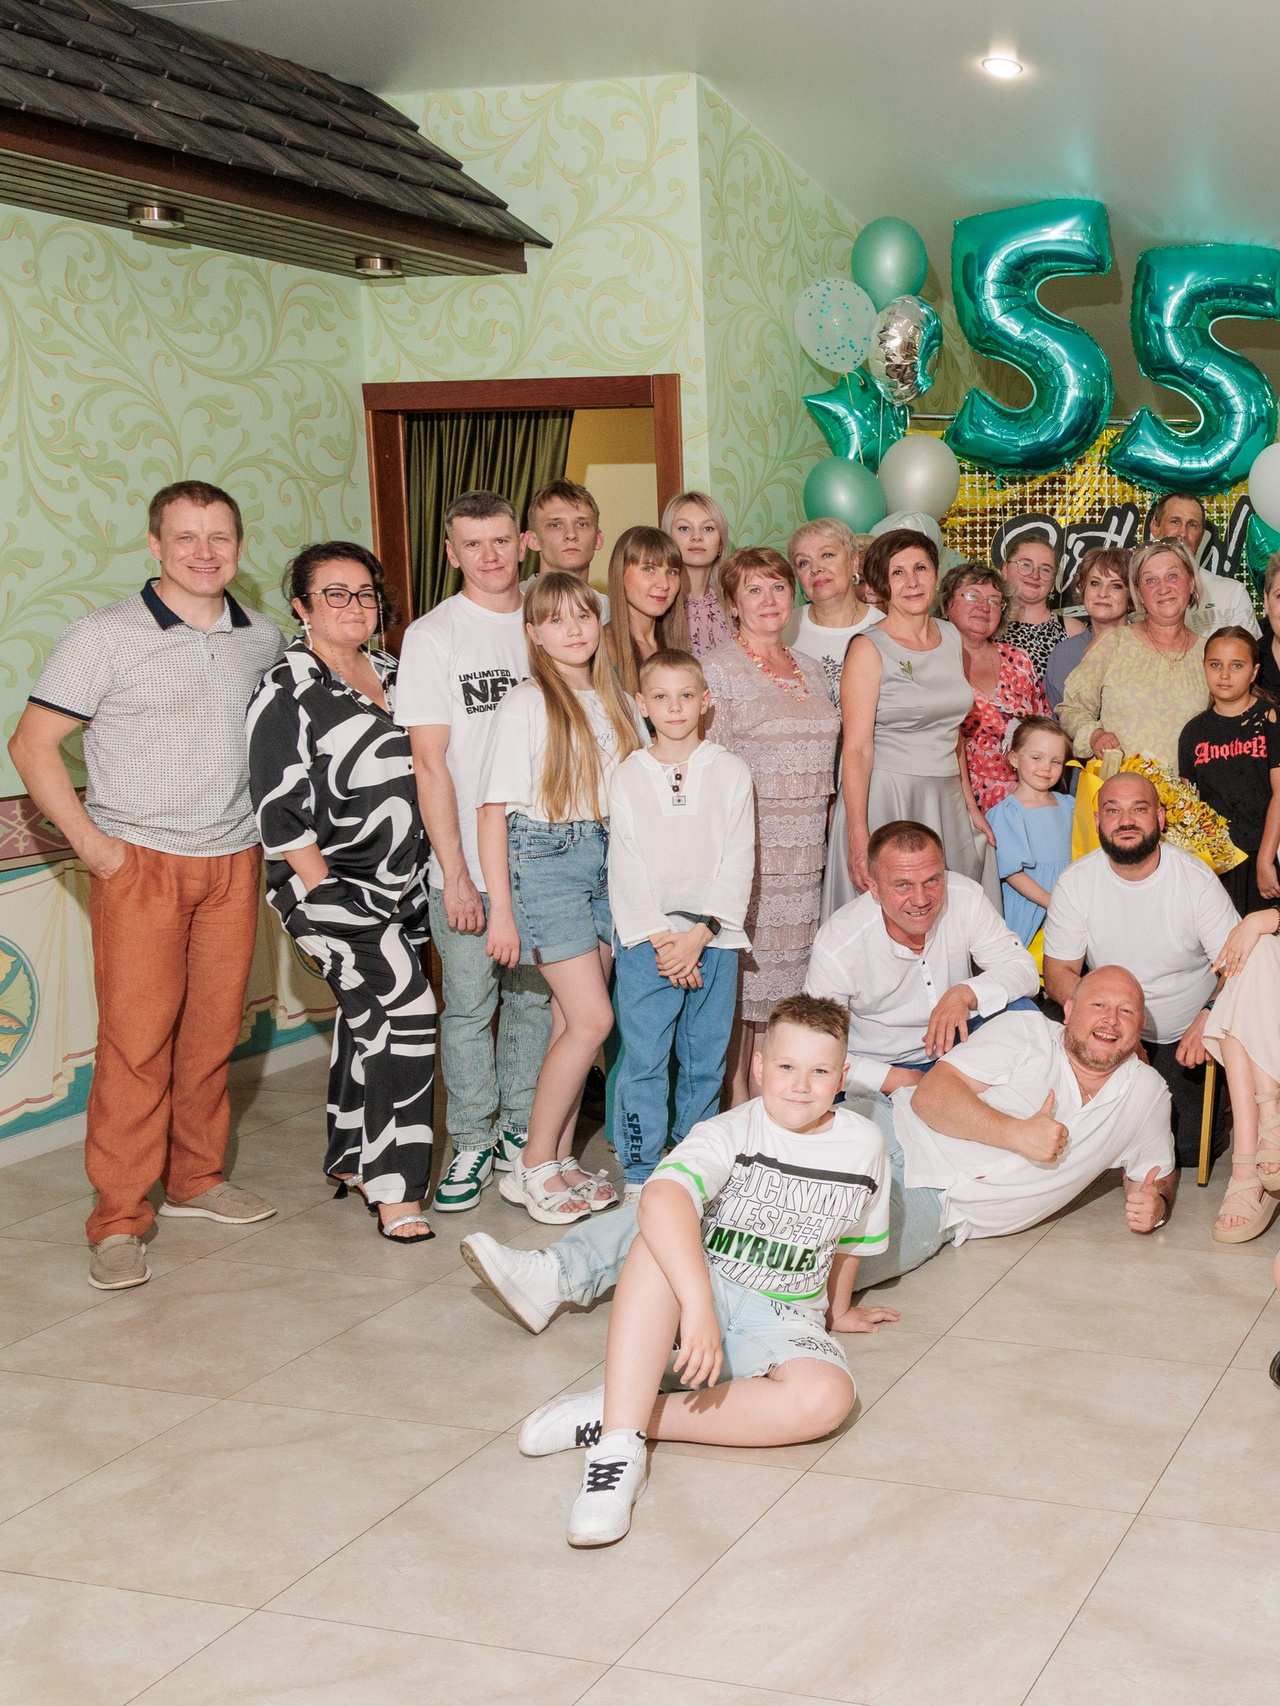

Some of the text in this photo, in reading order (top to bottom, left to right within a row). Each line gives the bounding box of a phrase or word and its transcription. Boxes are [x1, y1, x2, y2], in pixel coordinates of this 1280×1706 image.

[459, 669, 511, 682] UNLIMITED
[461, 677, 531, 706] NE
[626, 1112, 643, 1163] SPEED
